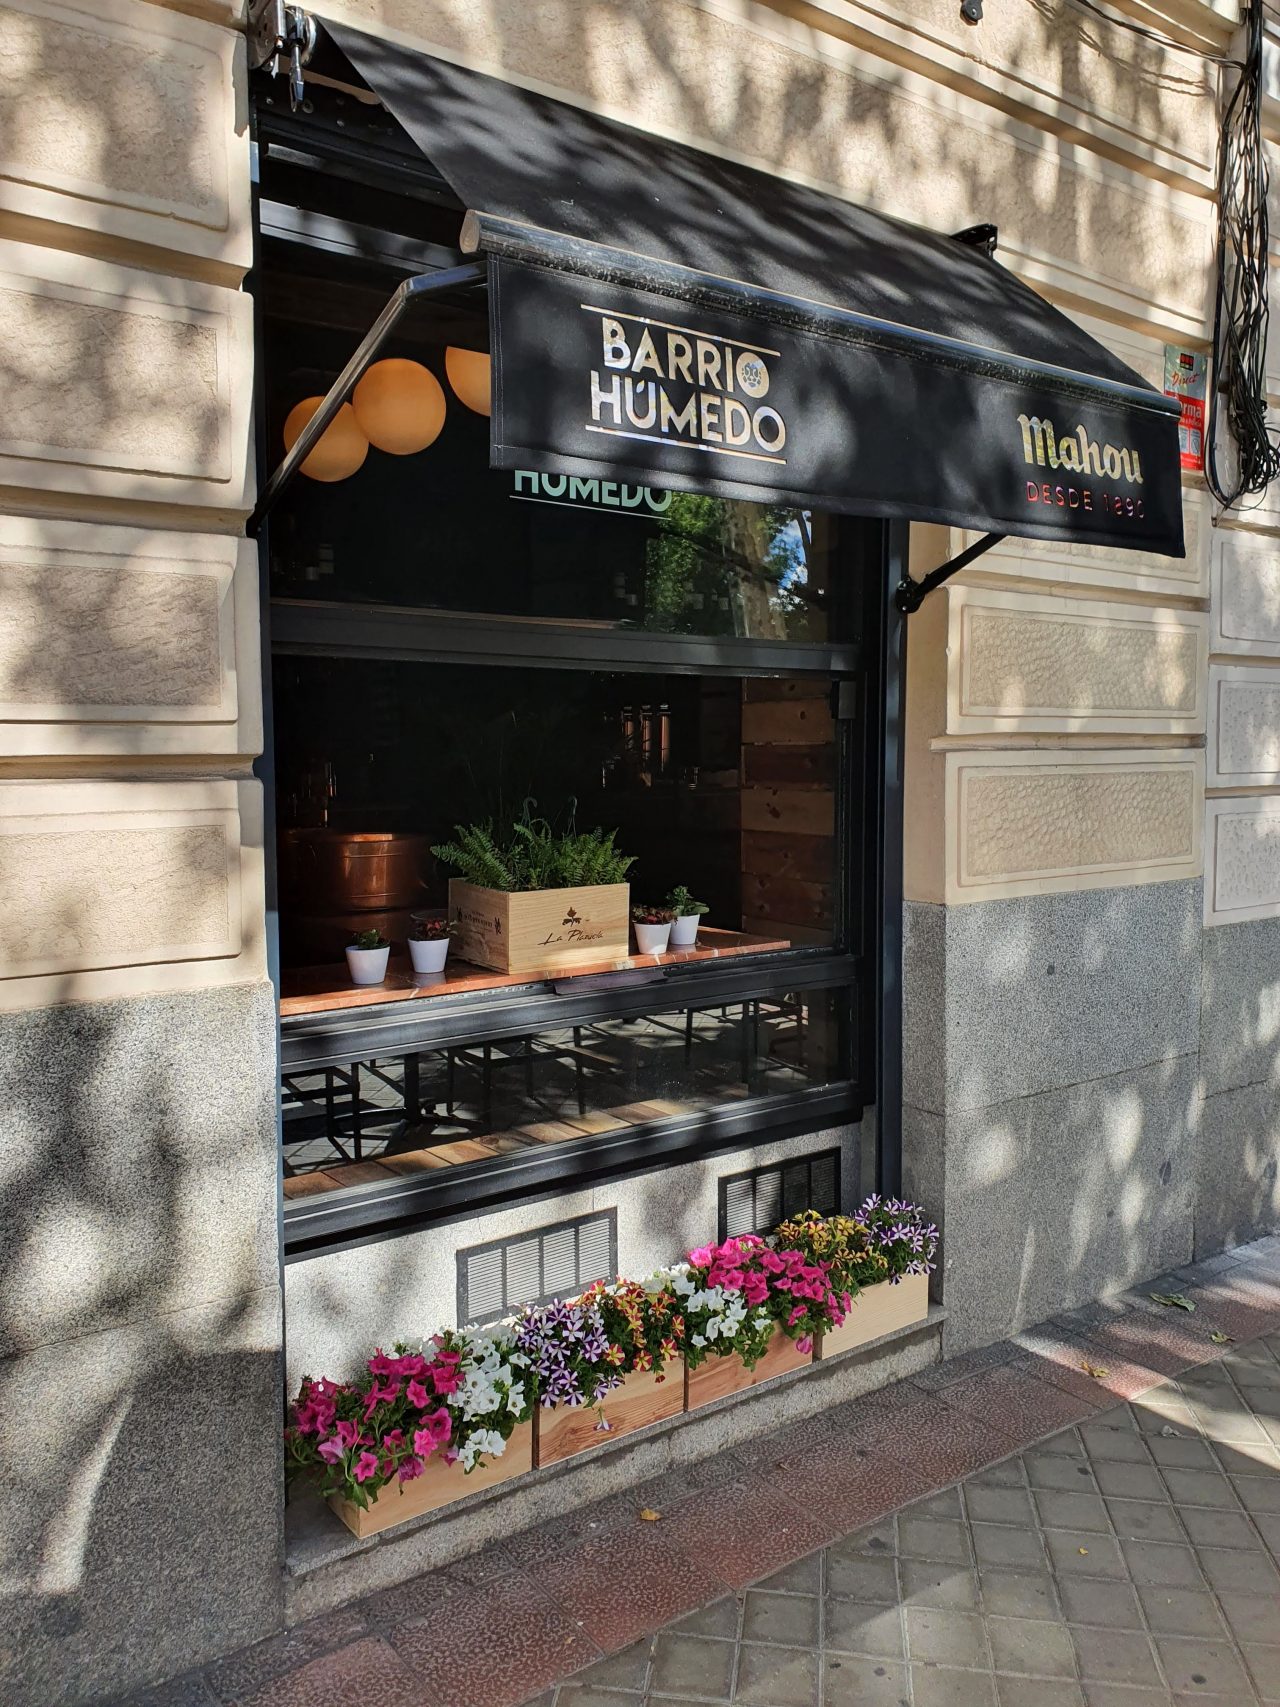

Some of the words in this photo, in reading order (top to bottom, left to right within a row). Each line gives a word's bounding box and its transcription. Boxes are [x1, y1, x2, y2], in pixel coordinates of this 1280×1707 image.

[602, 317, 770, 398] BARRIO
[1172, 371, 1200, 386] Direct
[590, 370, 786, 452] HÚMEDO
[1017, 414, 1144, 484] Mahou
[1026, 481, 1093, 511] DESDE
[537, 933, 562, 945] La
